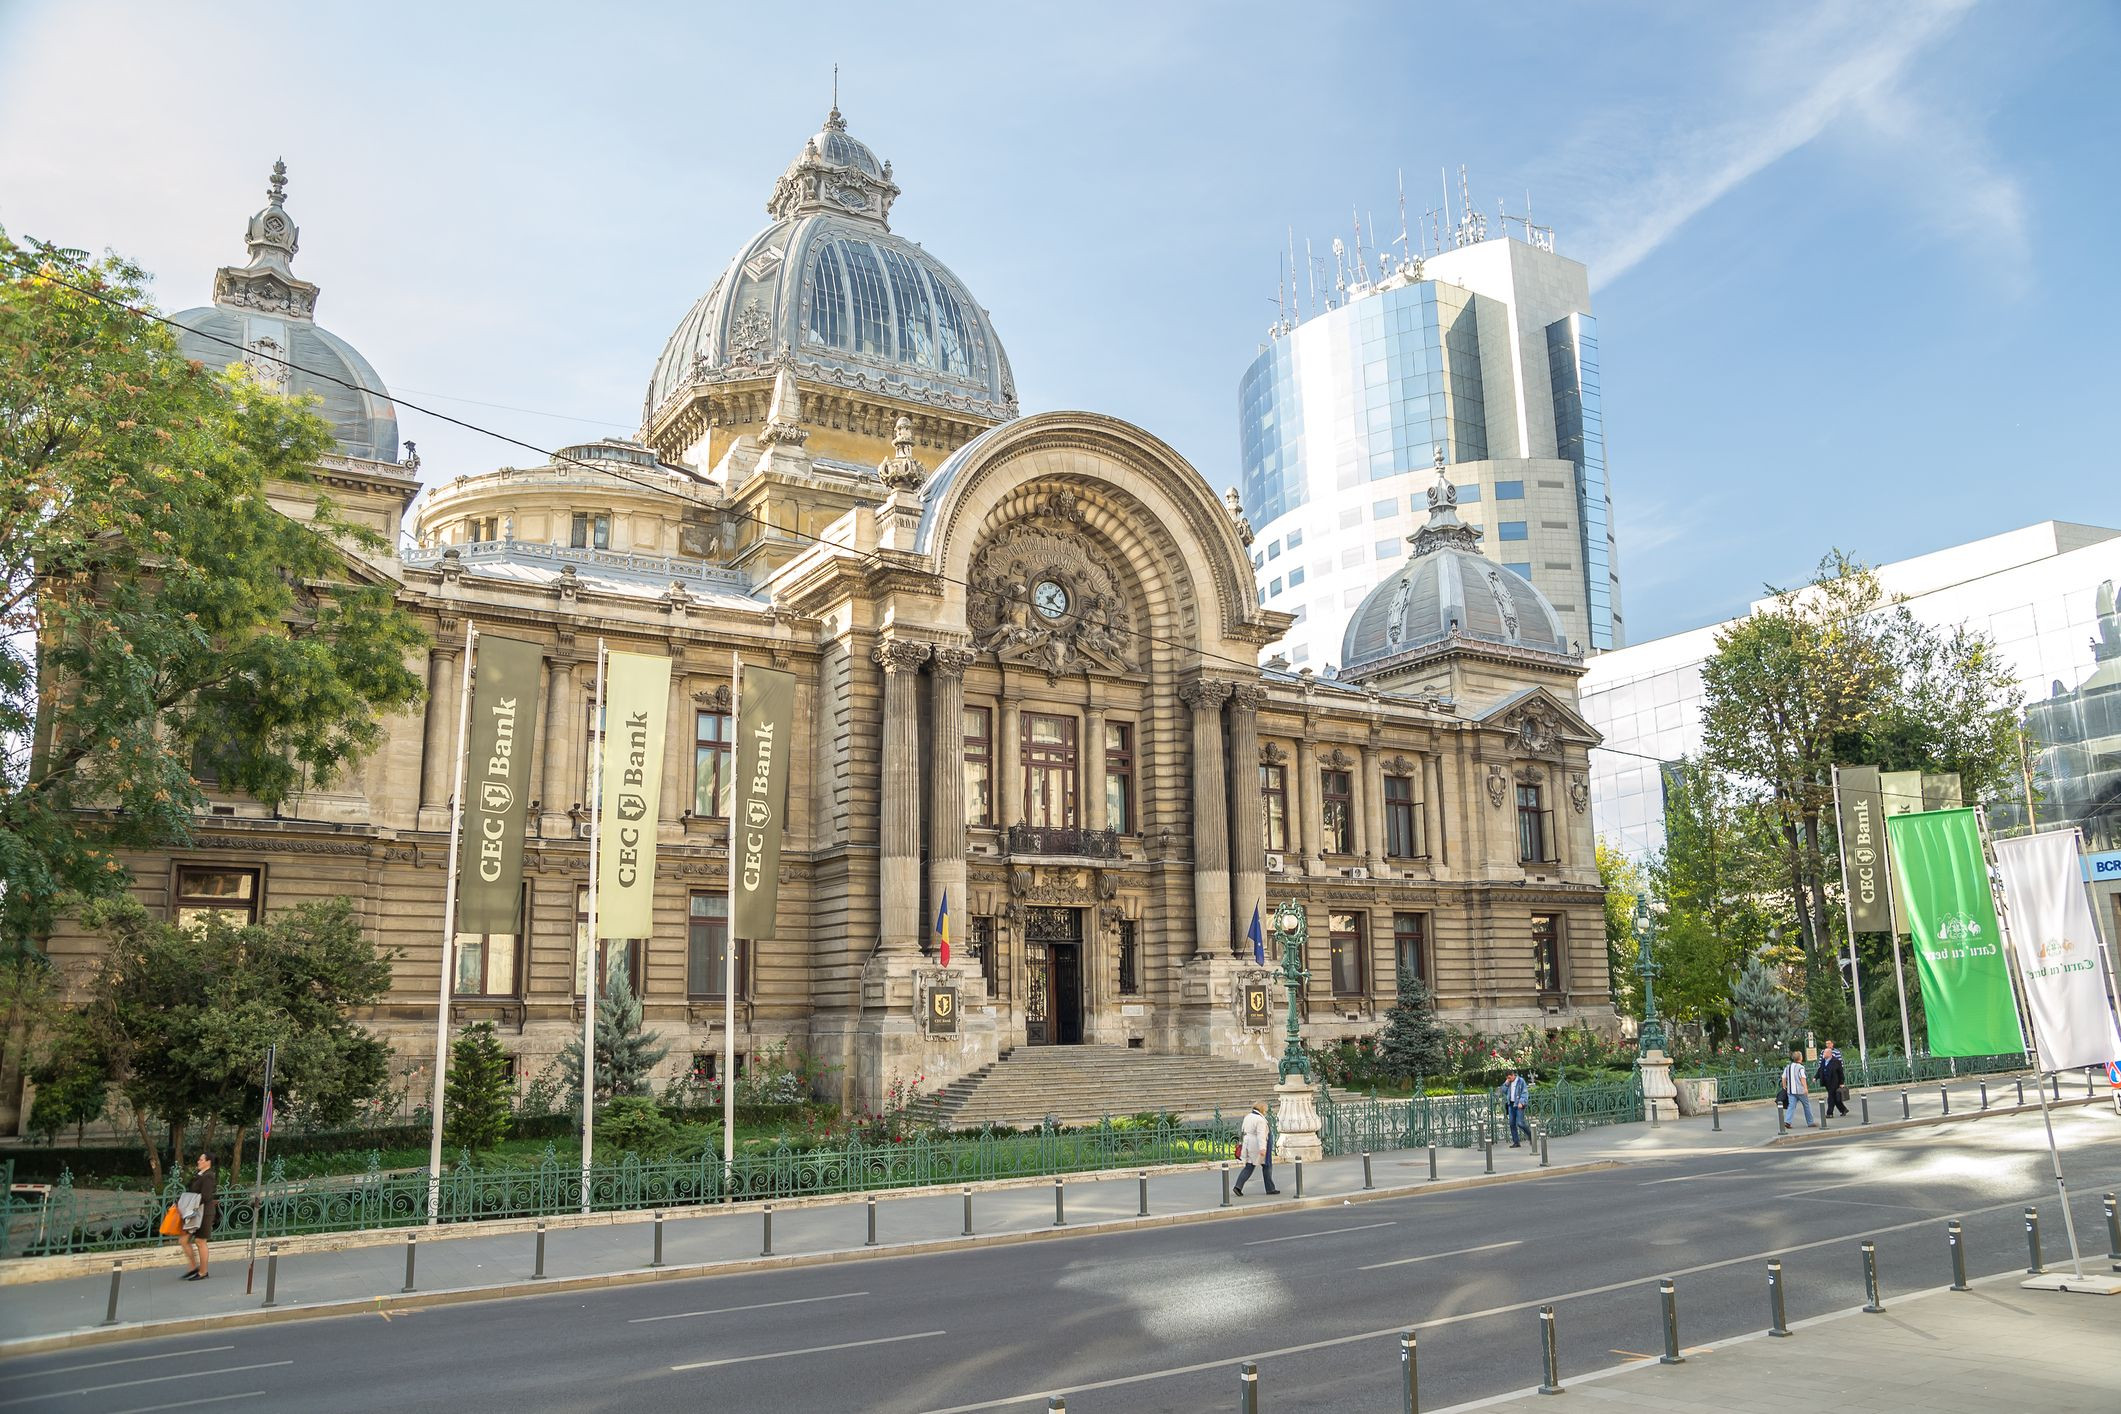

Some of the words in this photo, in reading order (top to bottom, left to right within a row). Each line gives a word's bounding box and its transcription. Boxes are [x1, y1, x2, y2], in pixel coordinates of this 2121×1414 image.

[488, 697, 517, 778] Bank
[623, 711, 648, 788] Bank
[752, 721, 774, 796] Bank
[479, 818, 505, 882] CEC
[1853, 799, 1872, 845] Bank
[618, 827, 639, 888] CEC
[743, 833, 764, 892] CEC
[1859, 867, 1875, 904] CEC
[2096, 860, 2121, 872] BCR
